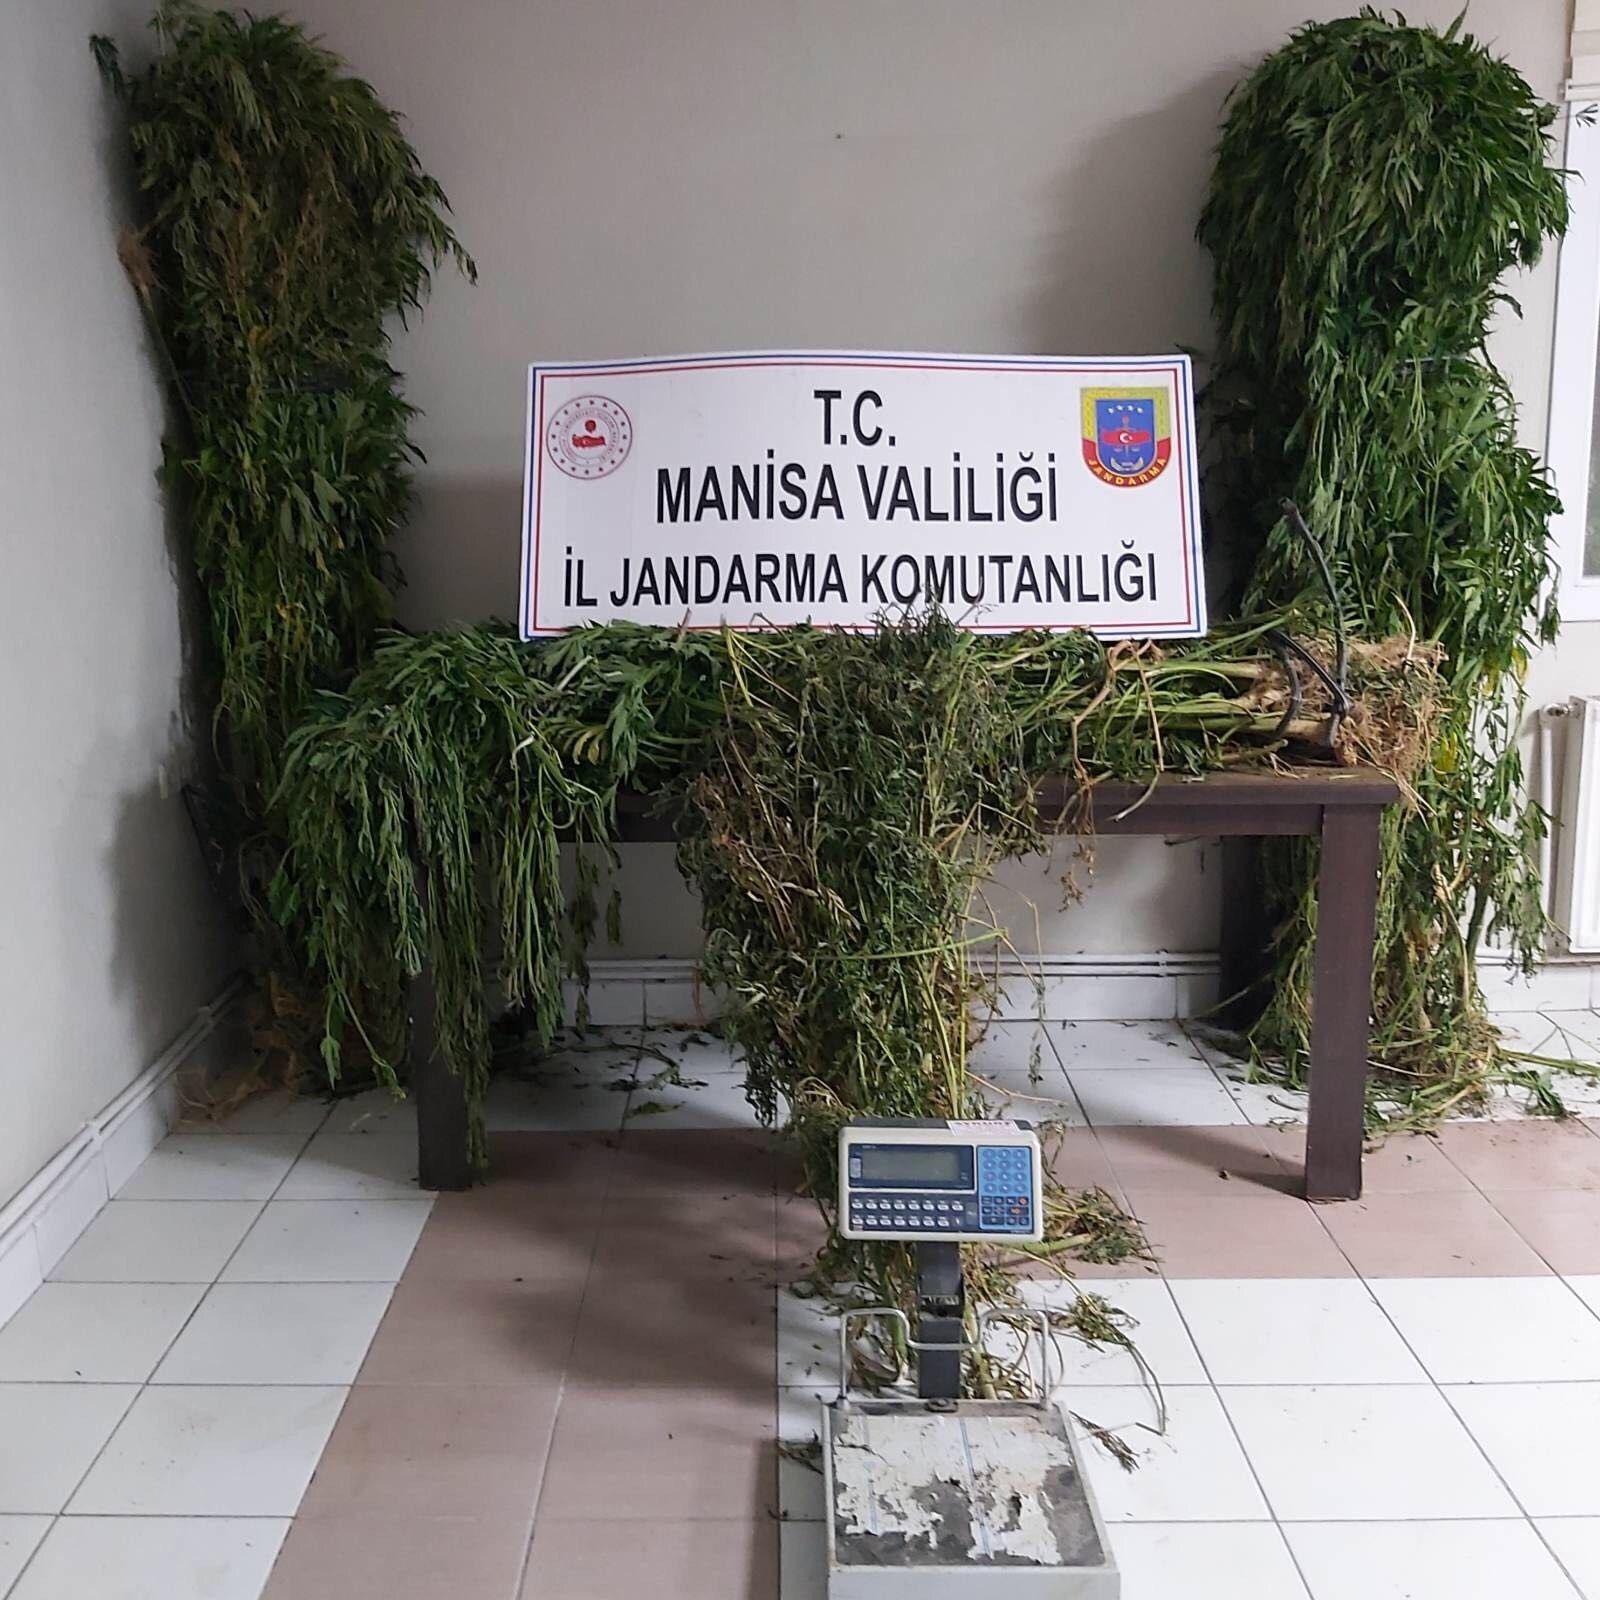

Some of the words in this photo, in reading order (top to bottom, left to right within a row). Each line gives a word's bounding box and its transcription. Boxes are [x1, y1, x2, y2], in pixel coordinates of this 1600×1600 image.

[813, 389, 896, 446] T.C.
[656, 448, 846, 524] MANİSA
[857, 451, 1057, 522] VALİLİĞİ
[1088, 459, 1167, 486] JANDARMA
[564, 546, 598, 607] İL
[609, 554, 848, 607] JANDARMA
[861, 540, 1157, 604] KOMUTANLIĞI
